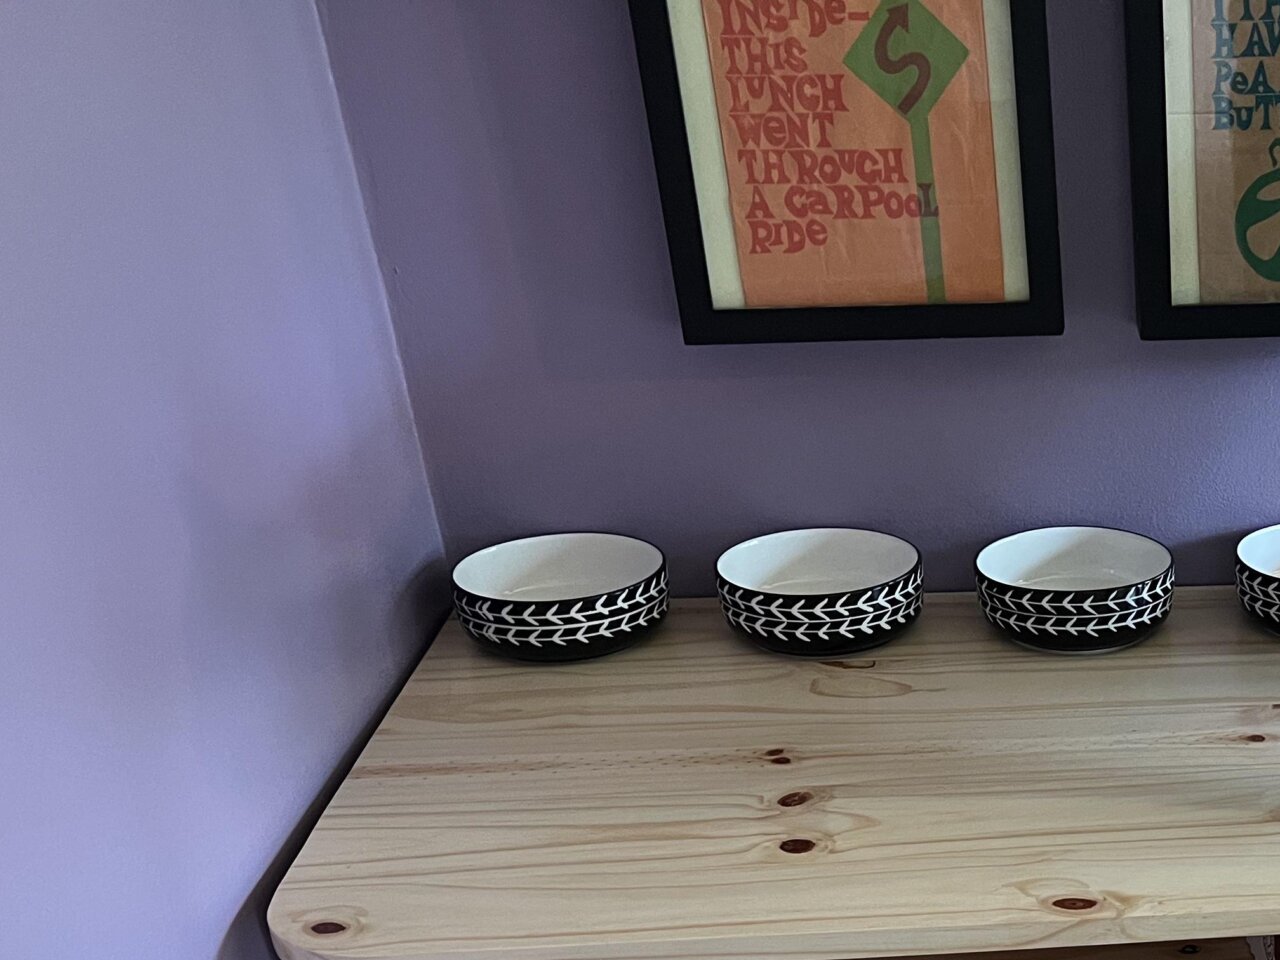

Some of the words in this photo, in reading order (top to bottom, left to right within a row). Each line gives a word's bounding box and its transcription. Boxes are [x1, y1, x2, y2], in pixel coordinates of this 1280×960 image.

[720, 37, 808, 74] THIS
[725, 74, 849, 112] LUNCH
[737, 148, 909, 184] THROUGH
[745, 185, 775, 219] A
